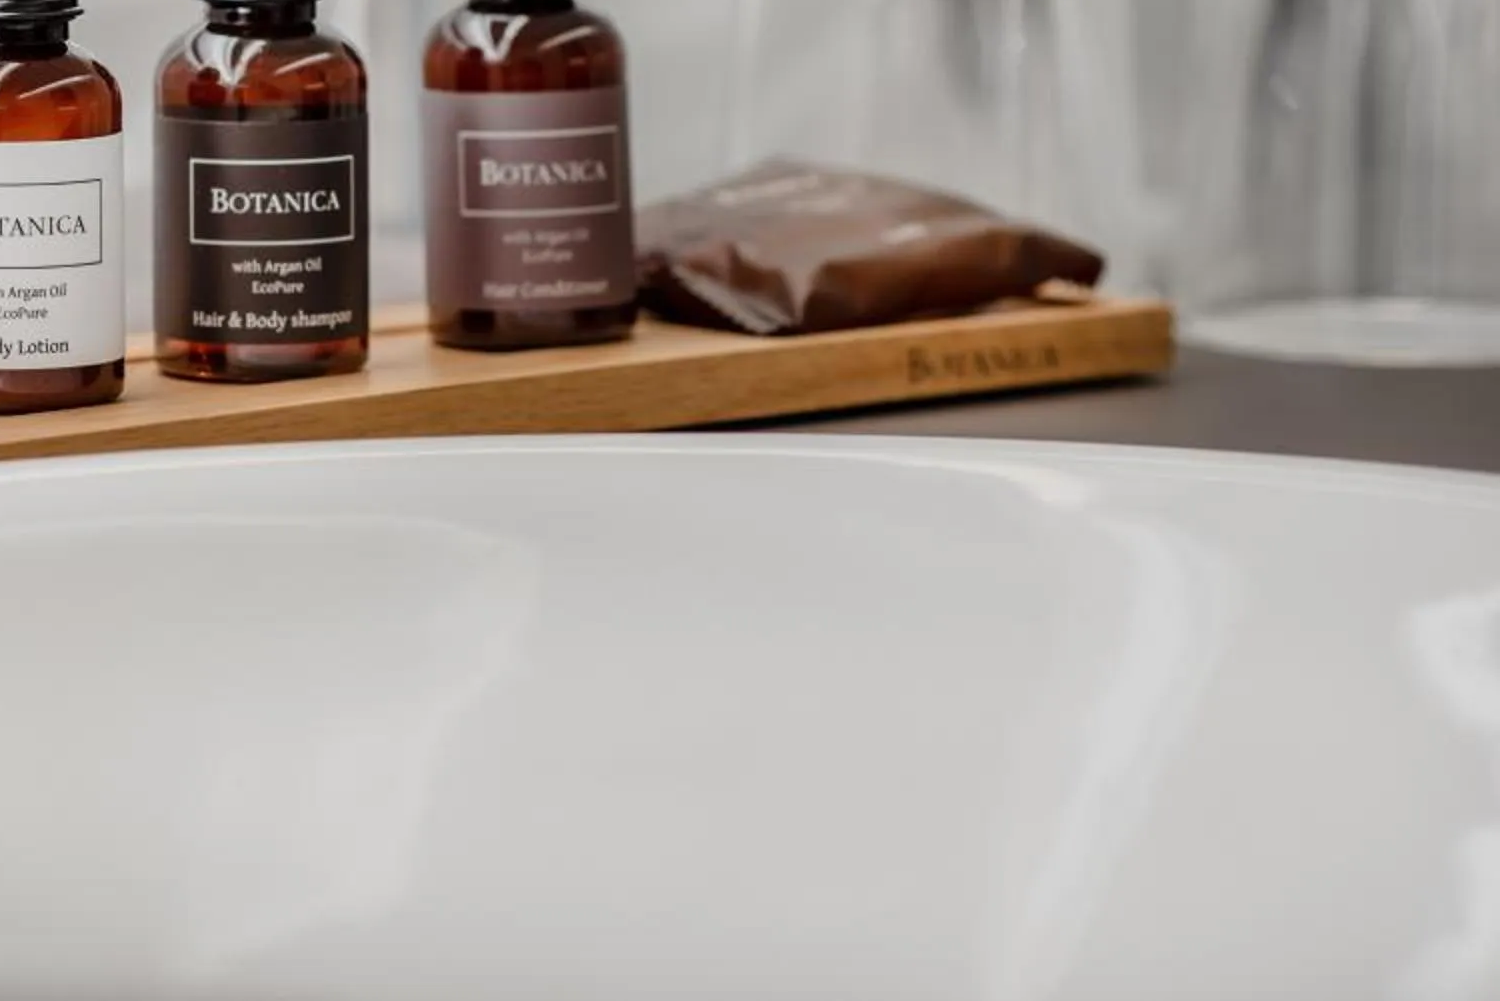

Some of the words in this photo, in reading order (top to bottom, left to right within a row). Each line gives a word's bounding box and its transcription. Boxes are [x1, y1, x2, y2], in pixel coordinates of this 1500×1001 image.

[479, 159, 608, 186] BOTANICA
[209, 187, 341, 214] BOTANICA
[231, 258, 261, 274] with
[264, 259, 302, 276] Argan
[305, 257, 322, 272] Oil
[7, 285, 47, 301] Argan
[50, 283, 67, 297] Oil
[251, 280, 304, 295] EcoPure
[193, 310, 226, 327] Hair
[228, 311, 242, 328] &
[245, 311, 287, 332] Body
[18, 339, 69, 355] Lotion
